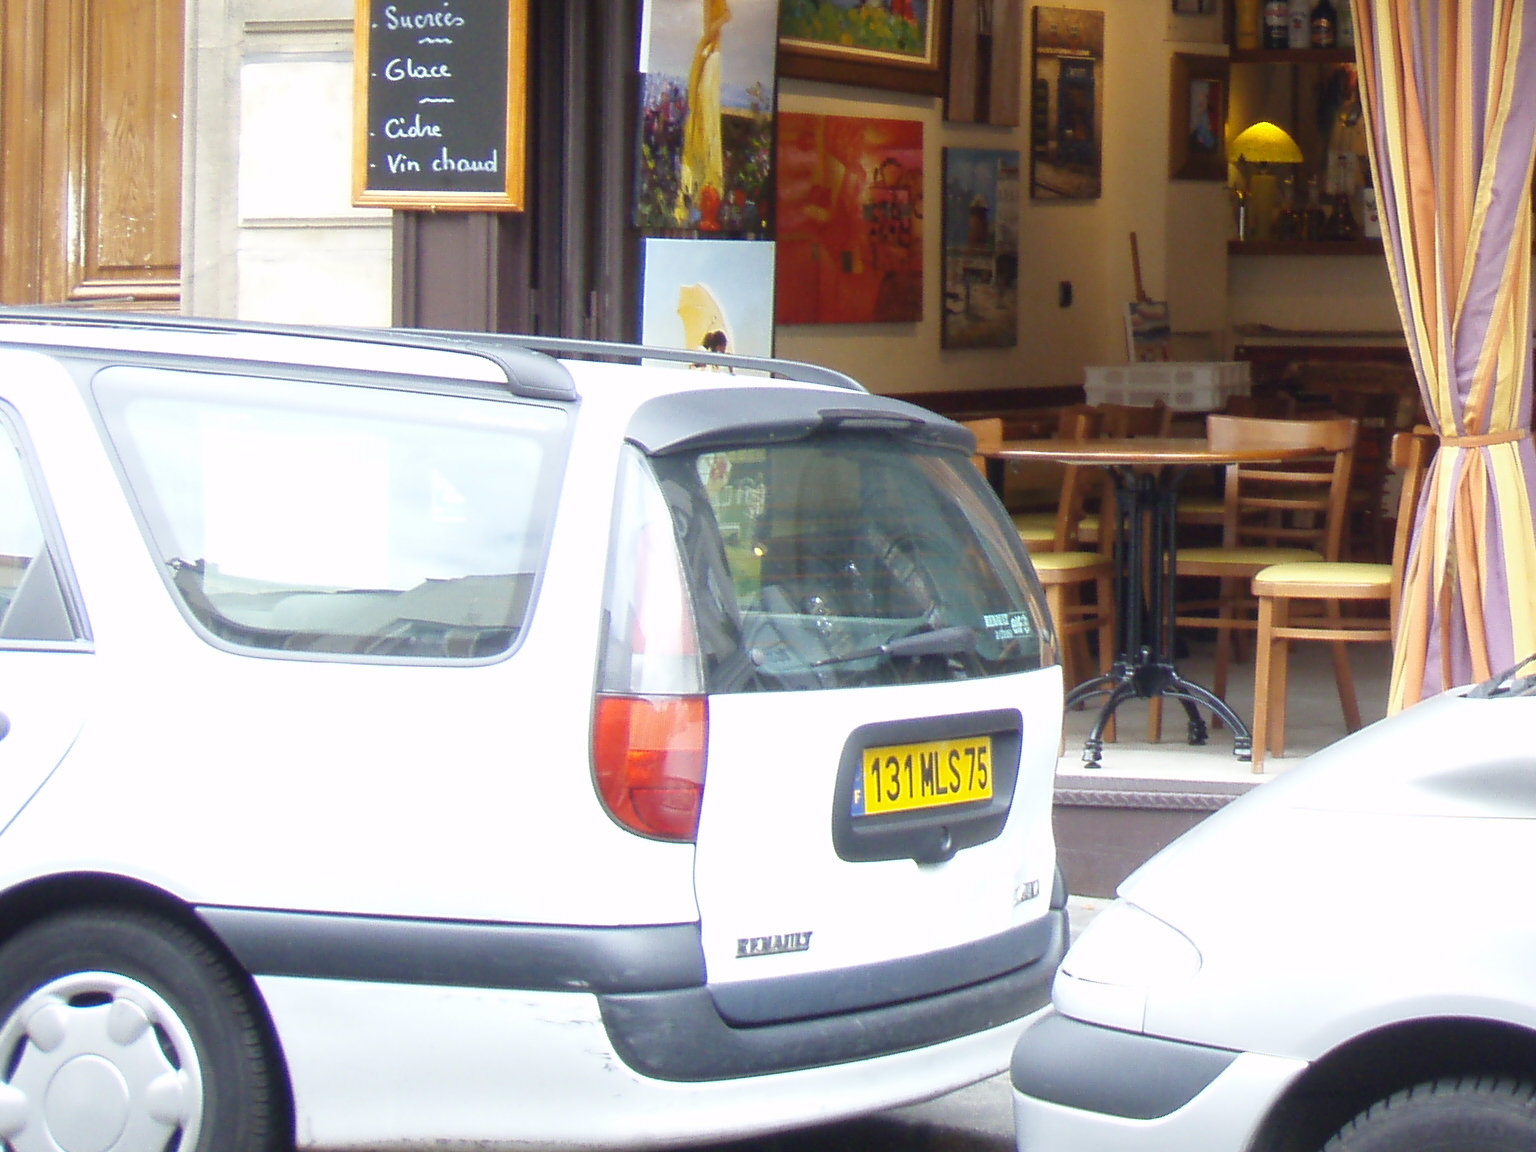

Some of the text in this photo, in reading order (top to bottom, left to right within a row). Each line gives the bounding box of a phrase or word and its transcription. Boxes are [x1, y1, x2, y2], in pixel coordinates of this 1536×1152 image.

[385, 57, 453, 82] Glace
[384, 113, 444, 139] Cidre
[386, 146, 498, 174] Vin chaud
[853, 789, 862, 804] F
